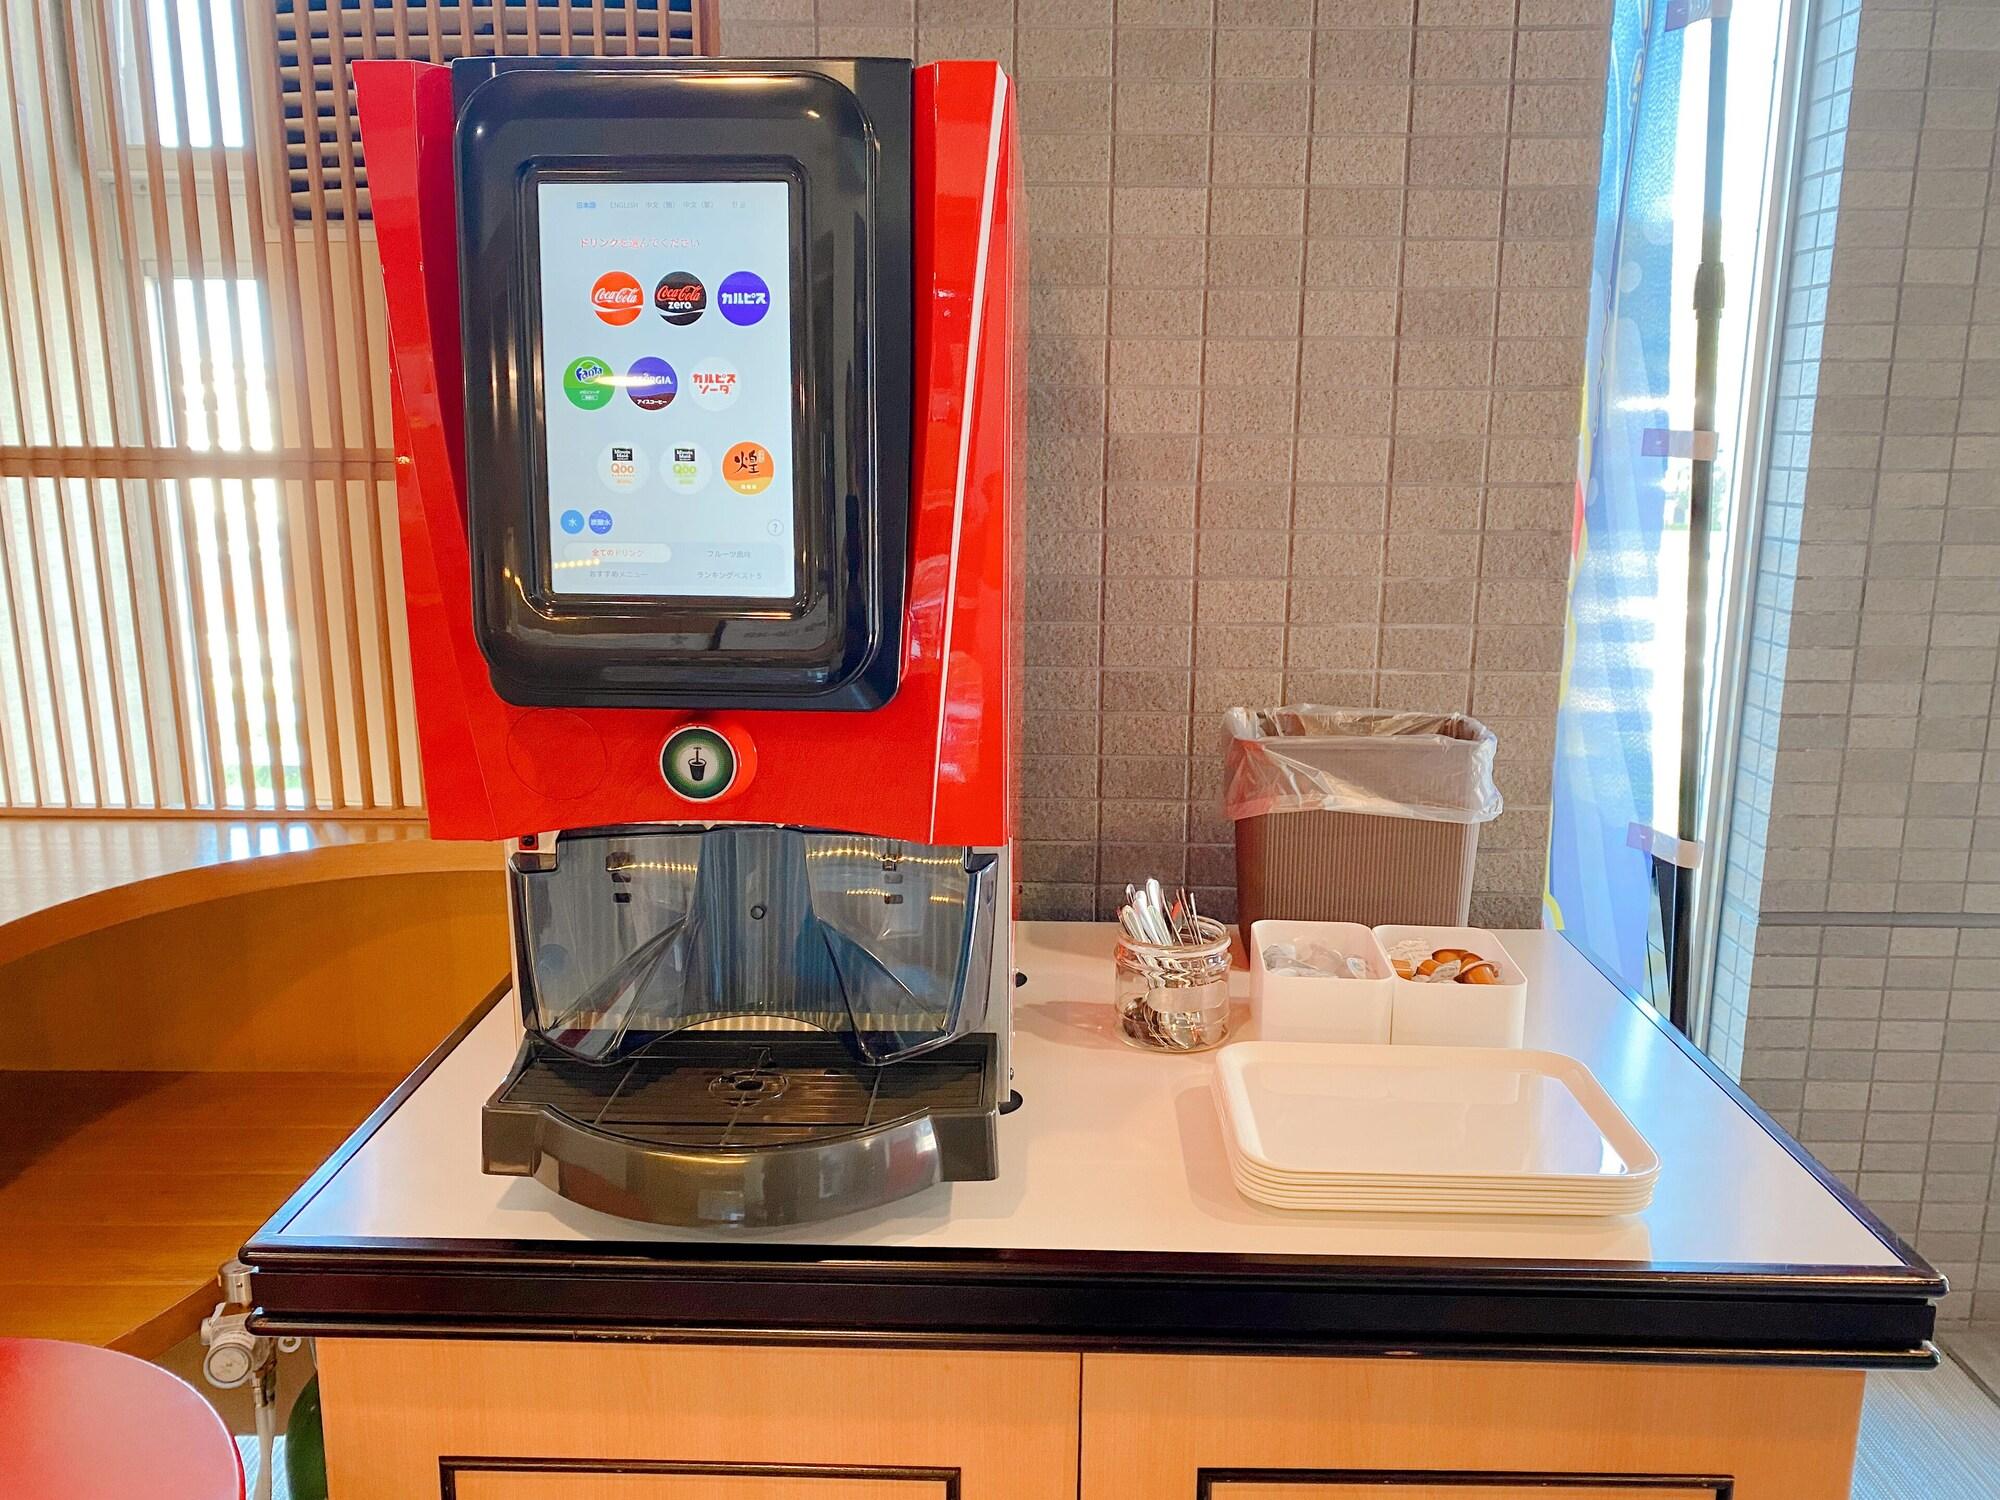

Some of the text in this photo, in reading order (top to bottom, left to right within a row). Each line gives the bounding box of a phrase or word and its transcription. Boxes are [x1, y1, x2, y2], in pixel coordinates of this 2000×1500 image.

[610, 201, 639, 209] ENGLISH
[594, 287, 641, 304] Coca-Cola
[657, 285, 702, 301] Coca-Cola
[721, 292, 767, 305] カルピス
[668, 301, 692, 310] zero
[575, 365, 603, 382] Fanta
[692, 373, 737, 384] カルピス
[699, 384, 731, 395] ソーダ
[611, 463, 634, 474] Qoo
[673, 463, 697, 474] Qoo
[568, 517, 578, 528] 水
